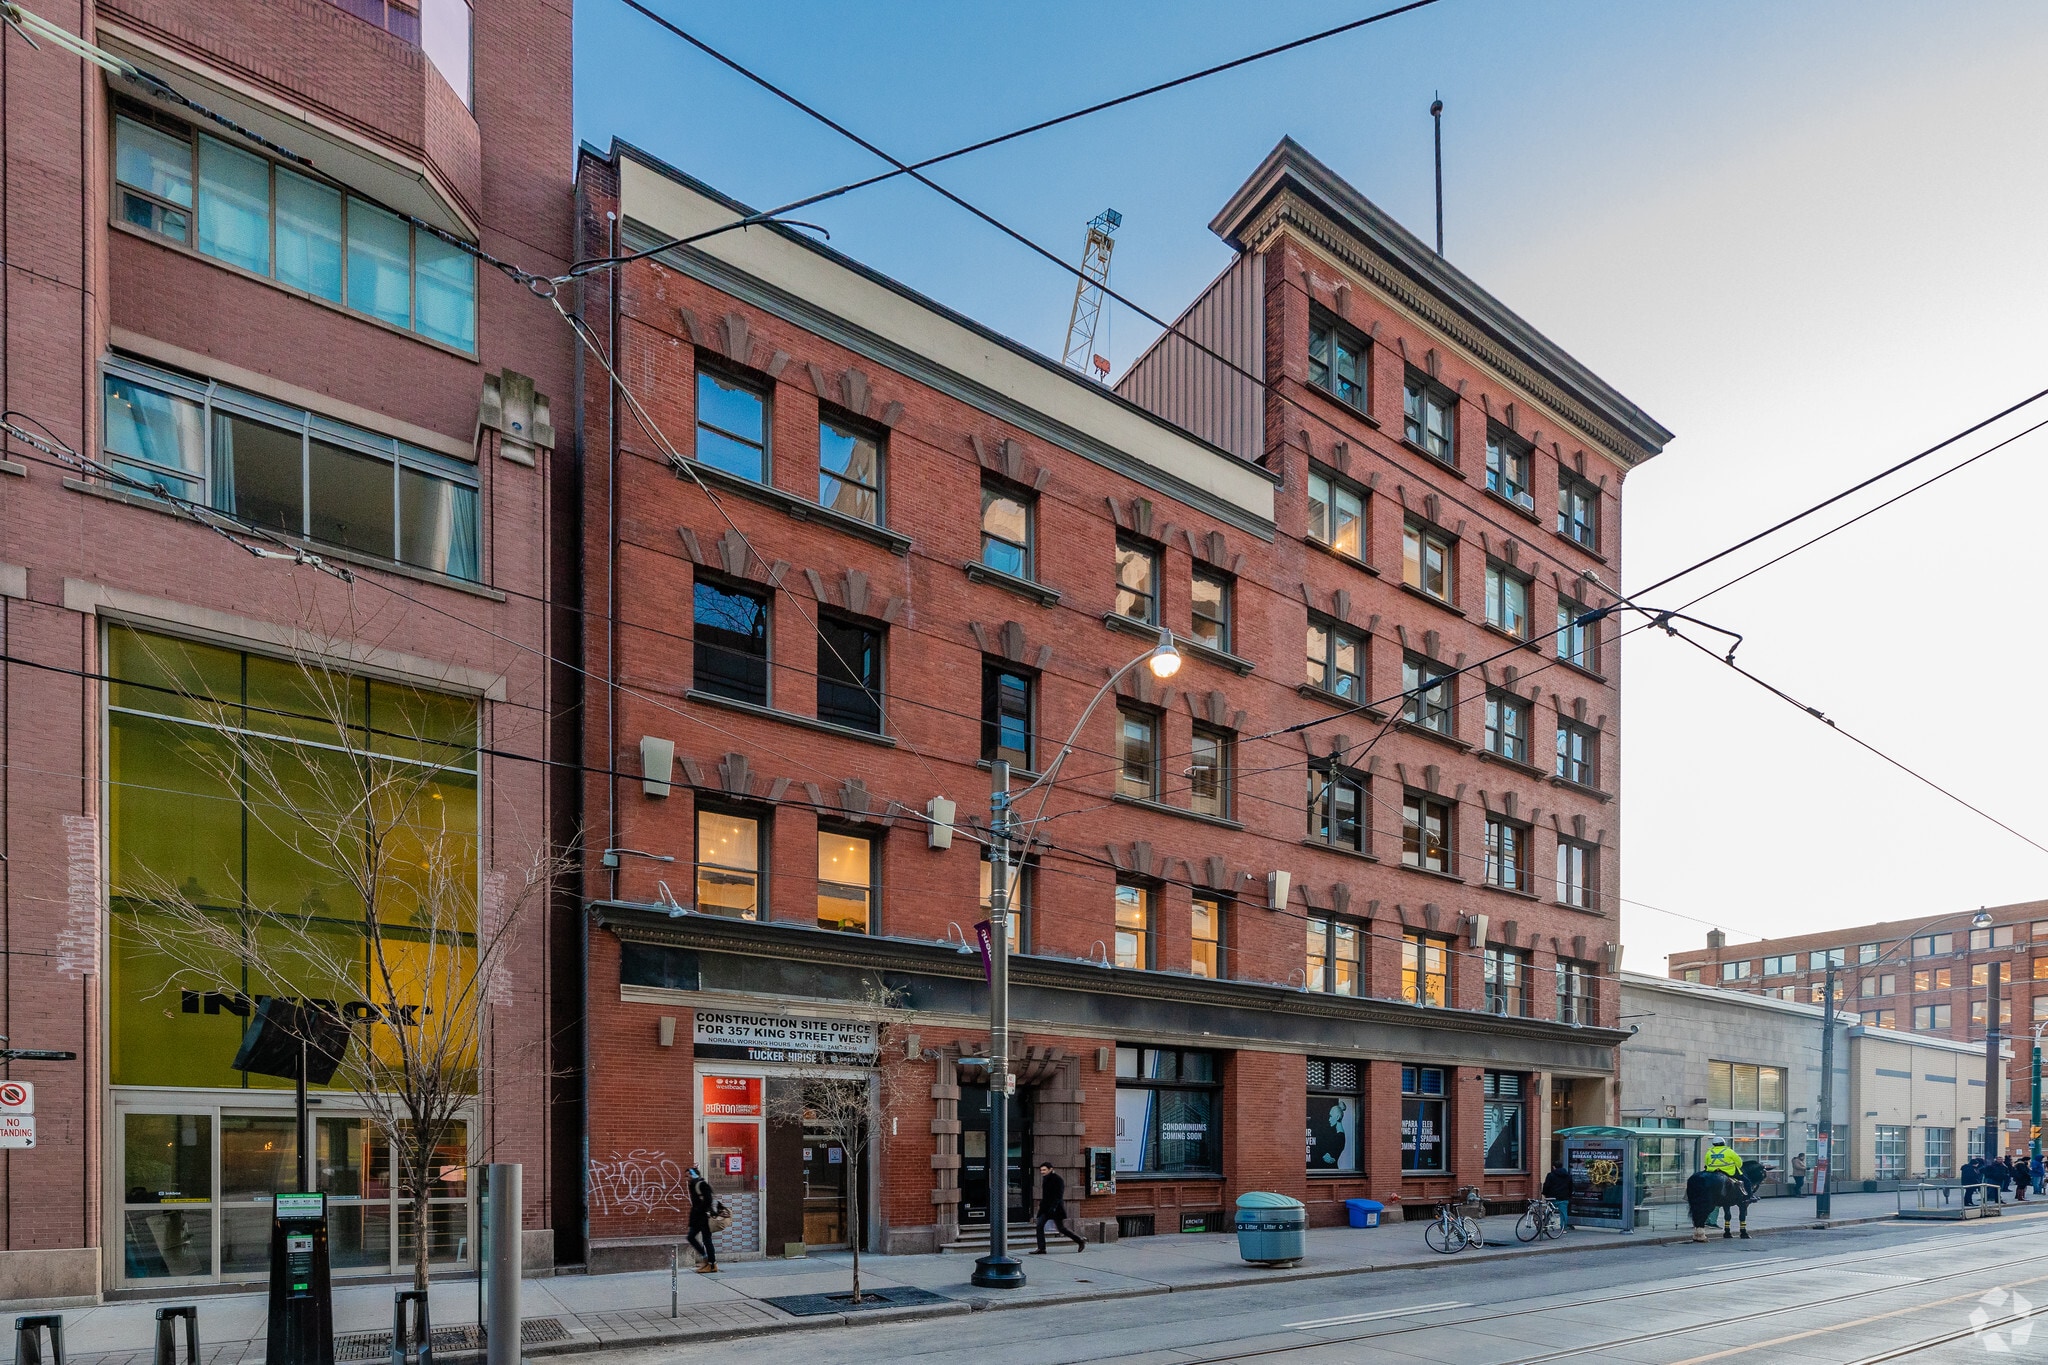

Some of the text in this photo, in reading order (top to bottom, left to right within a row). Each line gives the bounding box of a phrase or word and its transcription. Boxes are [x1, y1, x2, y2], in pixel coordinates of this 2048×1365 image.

[181, 990, 420, 1027] INOX
[696, 1012, 872, 1034] CONSTRUCTION SITE OFFICE
[697, 1024, 870, 1044] FOR 357 KING STREET WEST
[748, 1049, 817, 1063] TUCKER HIRISE
[705, 1103, 736, 1114] BURTON
[6, 1119, 20, 1127] NO
[1162, 1122, 1207, 1132] CONDOMINIUMS
[0, 1129, 32, 1137] TANDING
[1162, 1132, 1203, 1140] COMING SOON
